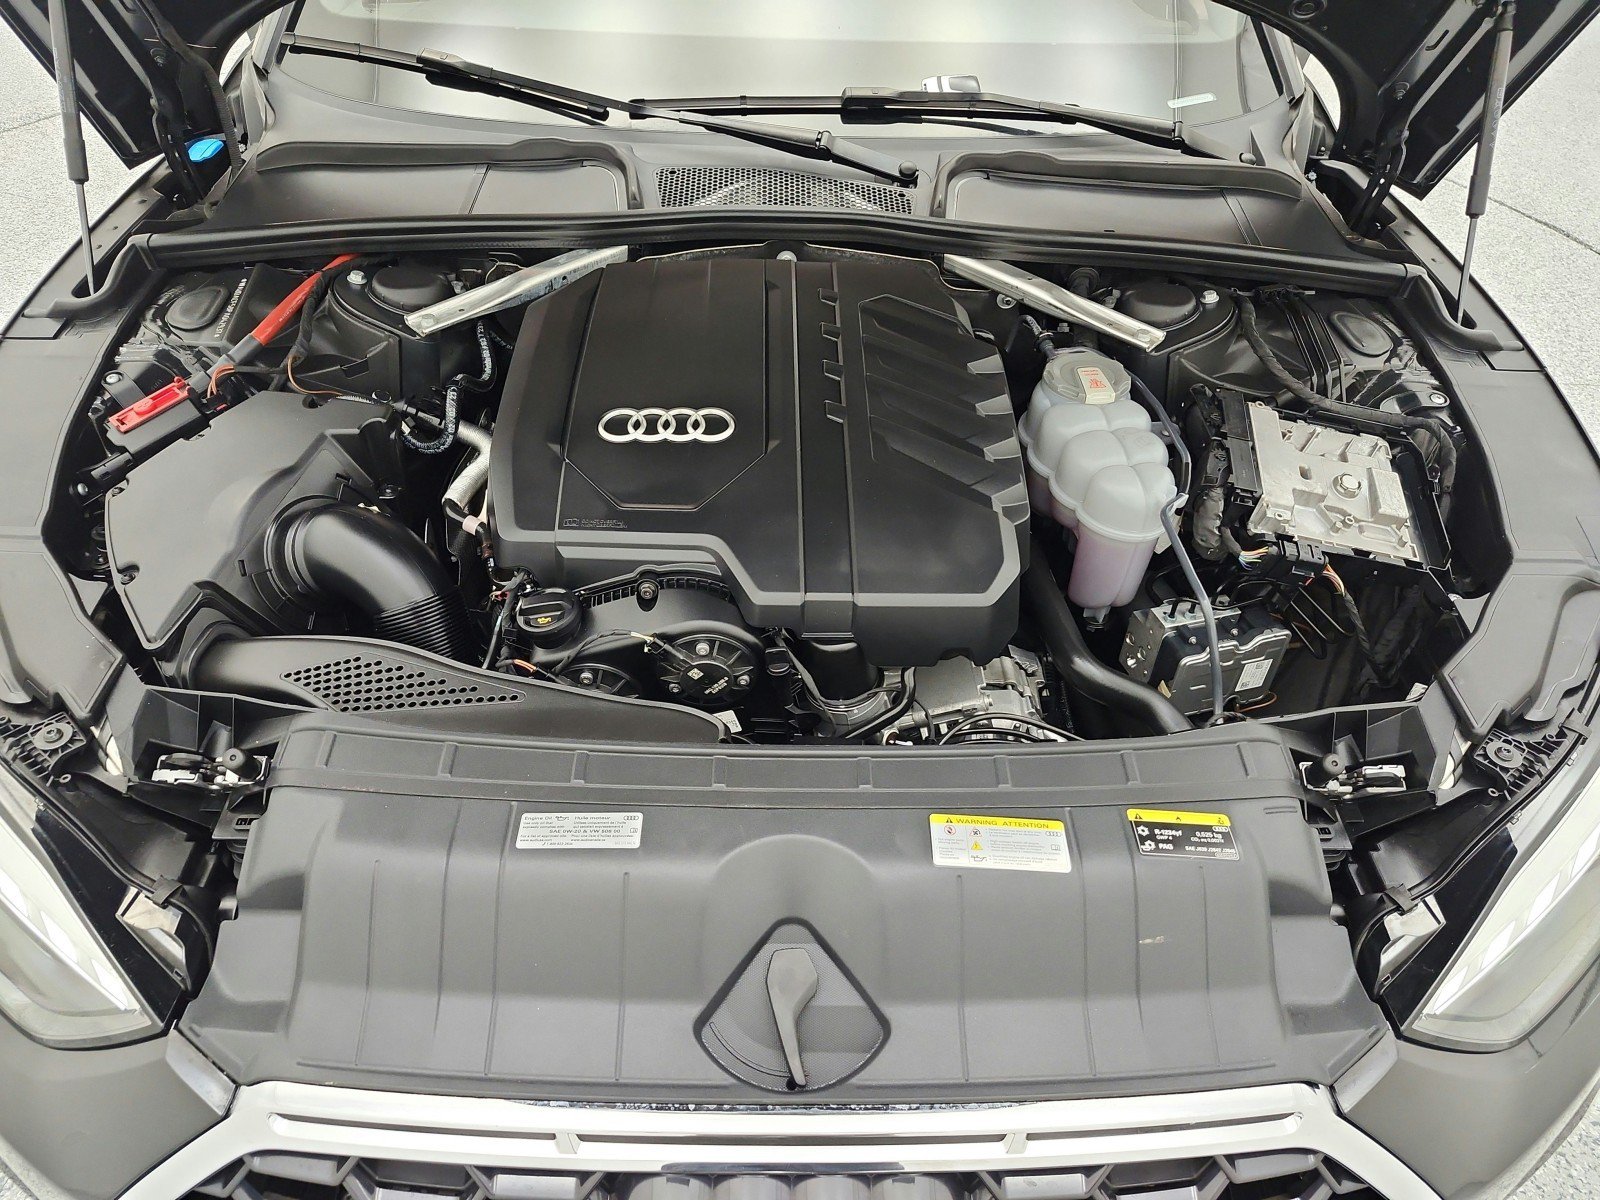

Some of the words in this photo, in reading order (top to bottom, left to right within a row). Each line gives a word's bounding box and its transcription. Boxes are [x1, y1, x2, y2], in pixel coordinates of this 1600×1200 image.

[955, 818, 998, 826] WARNING
[1002, 821, 1049, 829] ATTENTION
[1154, 828, 1182, 837] R-1234yf
